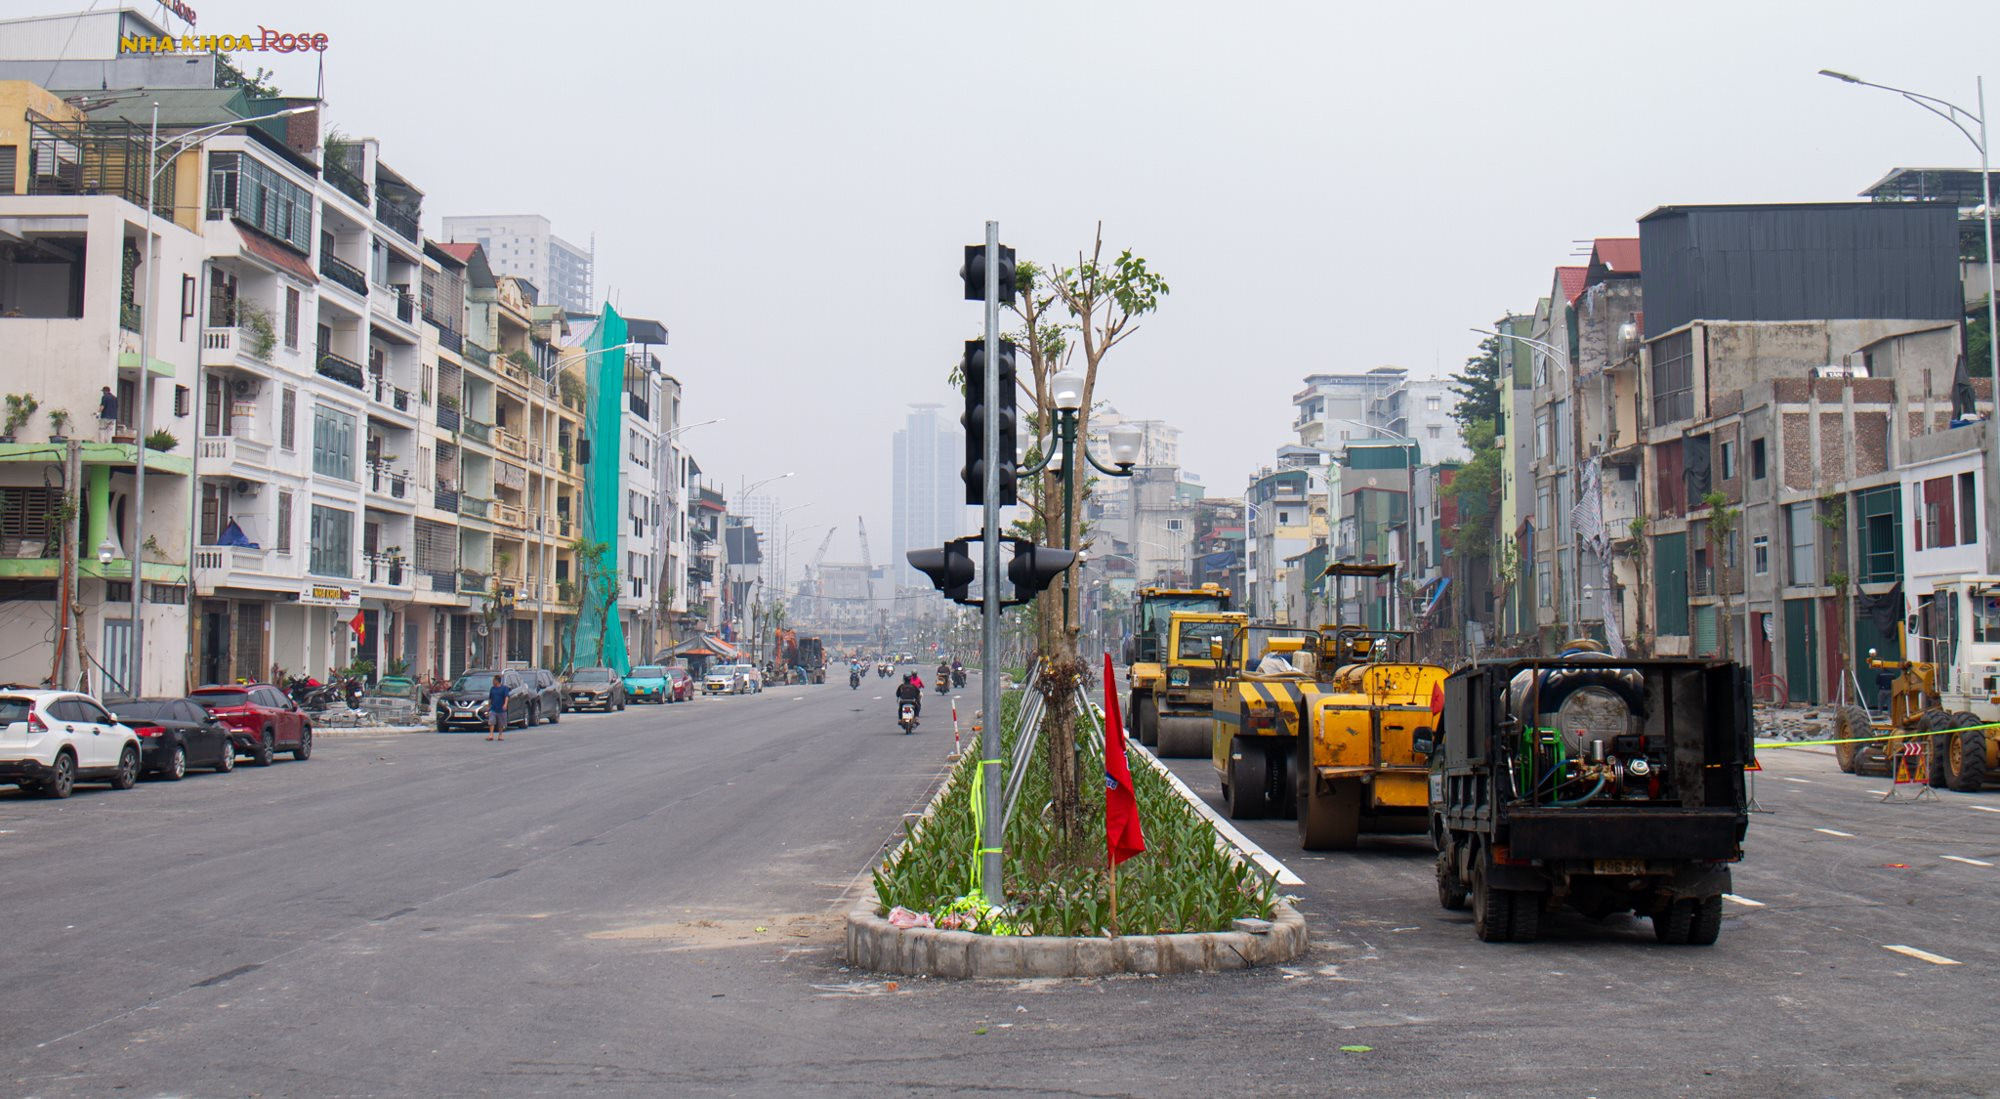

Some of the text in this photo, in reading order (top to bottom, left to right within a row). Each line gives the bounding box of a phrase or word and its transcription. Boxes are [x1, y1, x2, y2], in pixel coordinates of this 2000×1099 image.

[120, 25, 329, 54] NHA KHOA Rose
